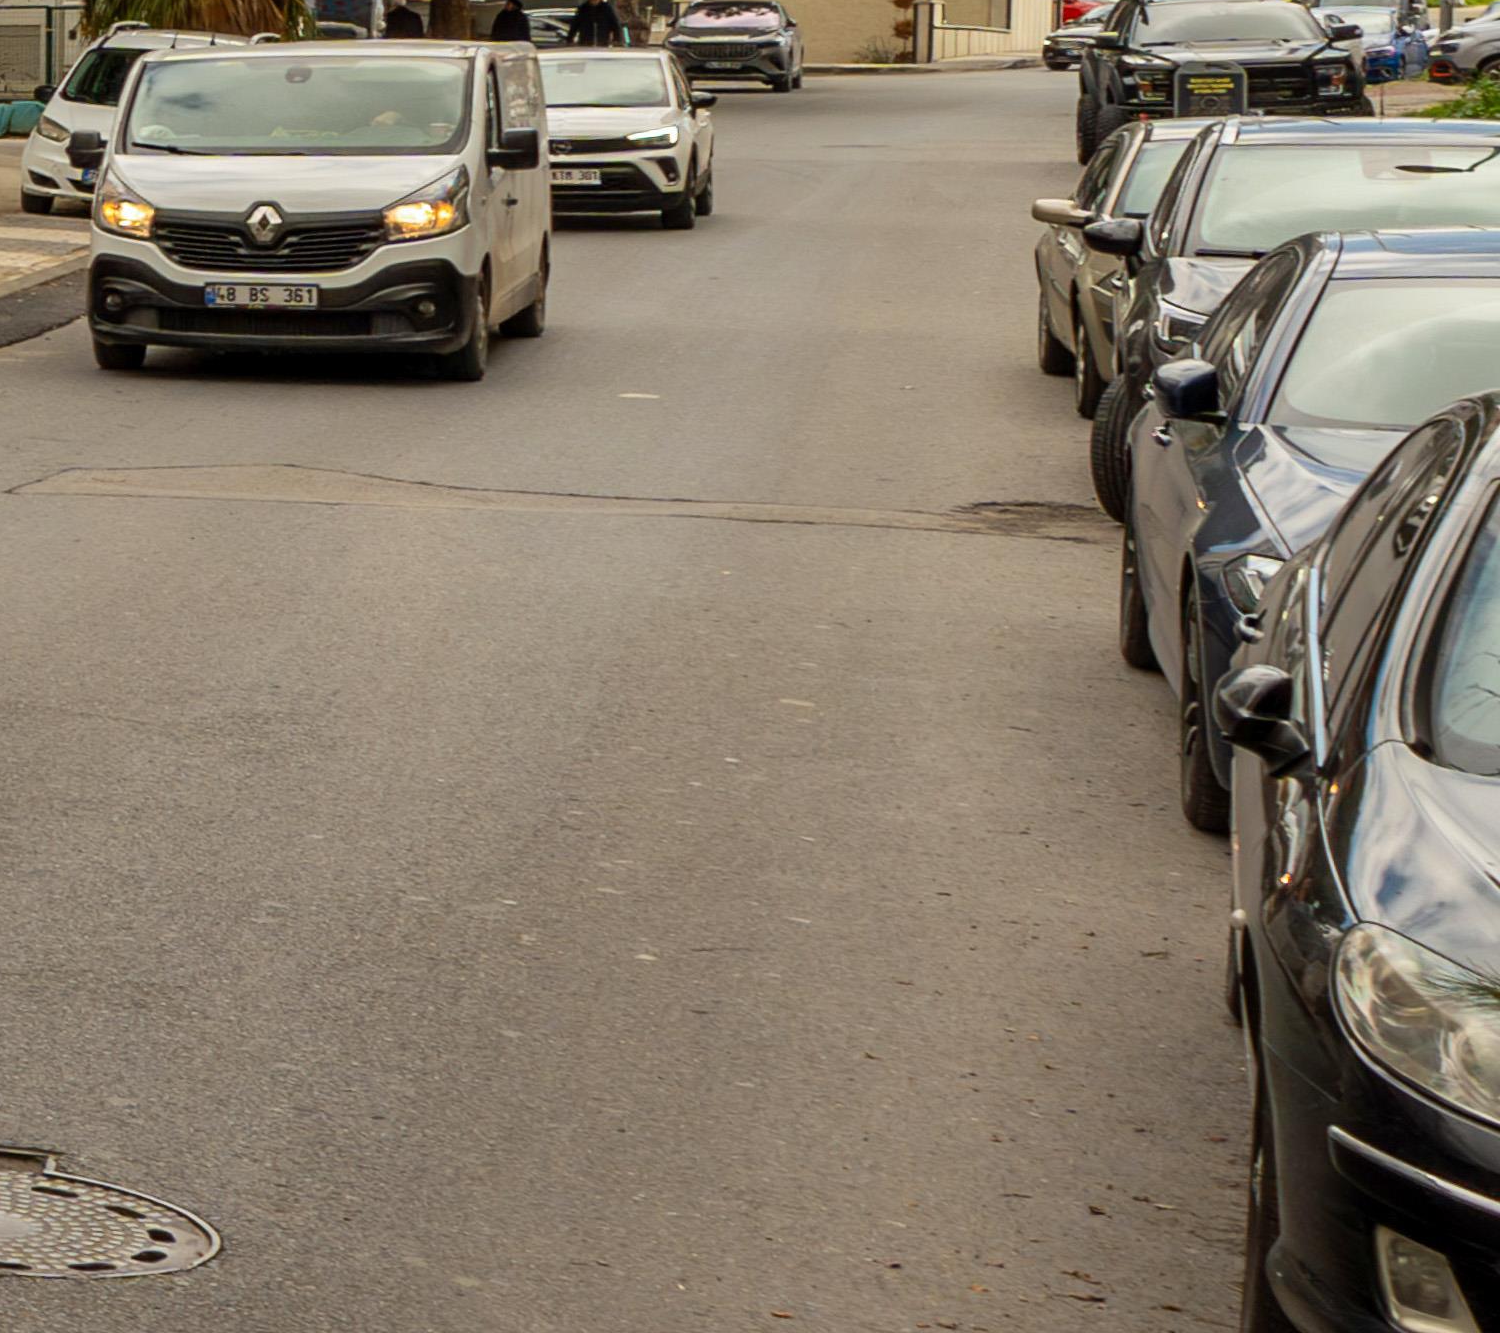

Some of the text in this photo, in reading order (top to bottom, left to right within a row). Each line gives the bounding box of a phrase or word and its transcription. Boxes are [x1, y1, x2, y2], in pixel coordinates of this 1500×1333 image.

[216, 286, 314, 303] 48 BS 361
